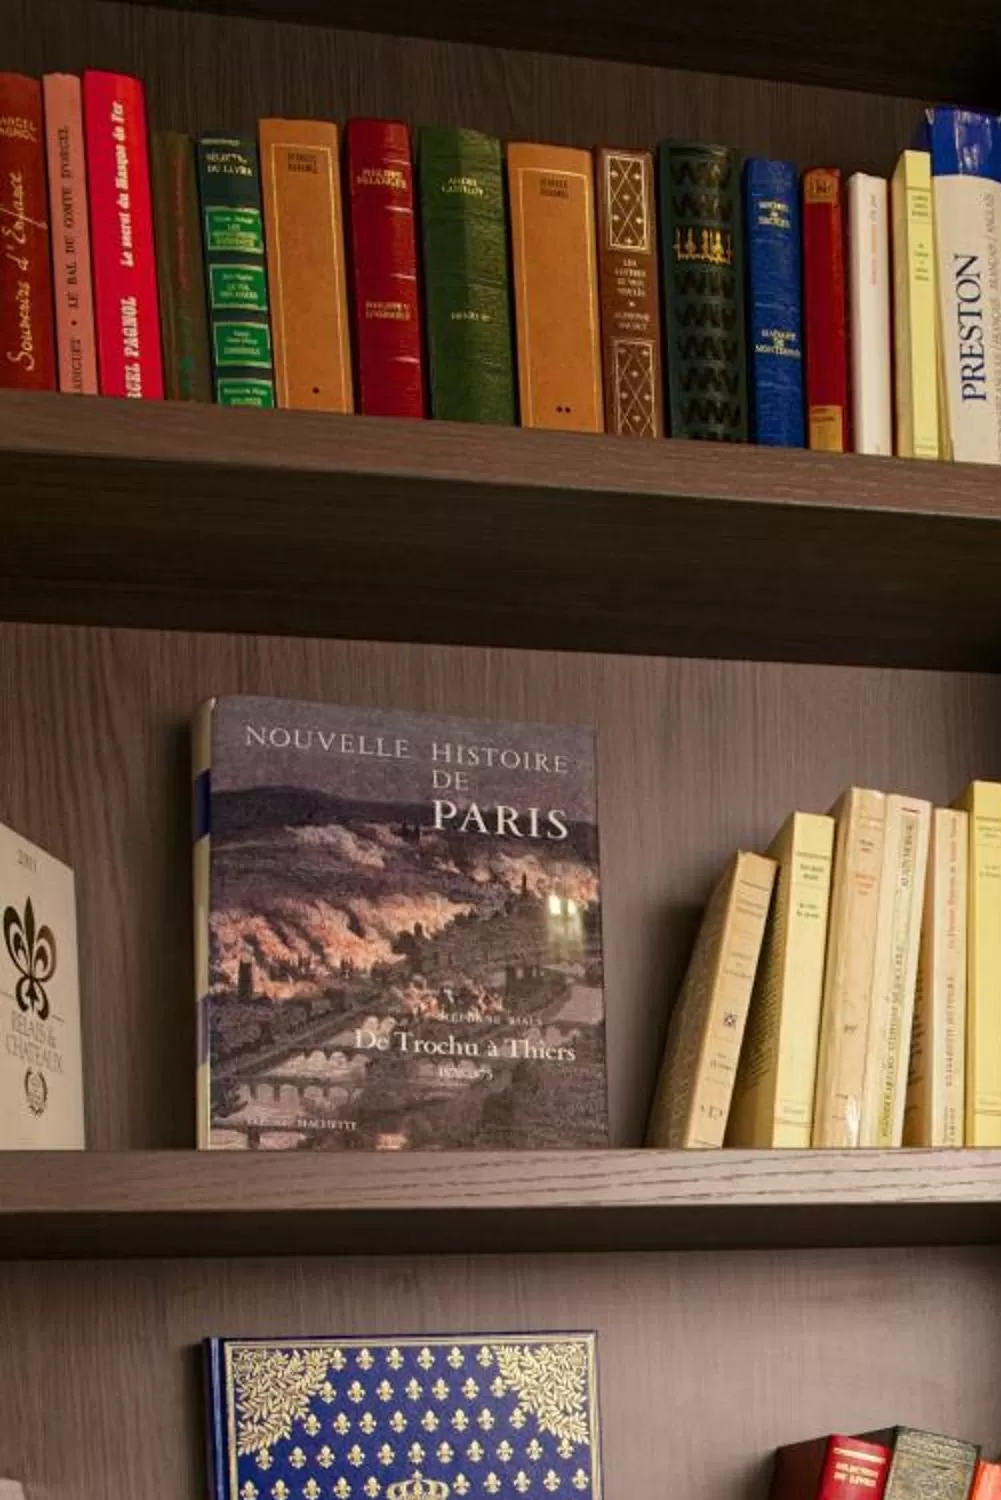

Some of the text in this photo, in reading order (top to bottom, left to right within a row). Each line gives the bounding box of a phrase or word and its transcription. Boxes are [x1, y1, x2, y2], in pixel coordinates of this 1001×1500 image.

[65, 264, 78, 285] BAL
[119, 250, 134, 268] Le
[66, 293, 79, 309] LE
[119, 296, 140, 358] PAGNOL
[953, 253, 987, 402] PRESTON
[70, 338, 83, 391] ADIGUET
[244, 725, 569, 774] NOUVELLE HISTOIRE
[431, 769, 470, 791] DE
[432, 798, 570, 840] PARIS
[355, 1029, 578, 1062] De Trochu à Thiers
